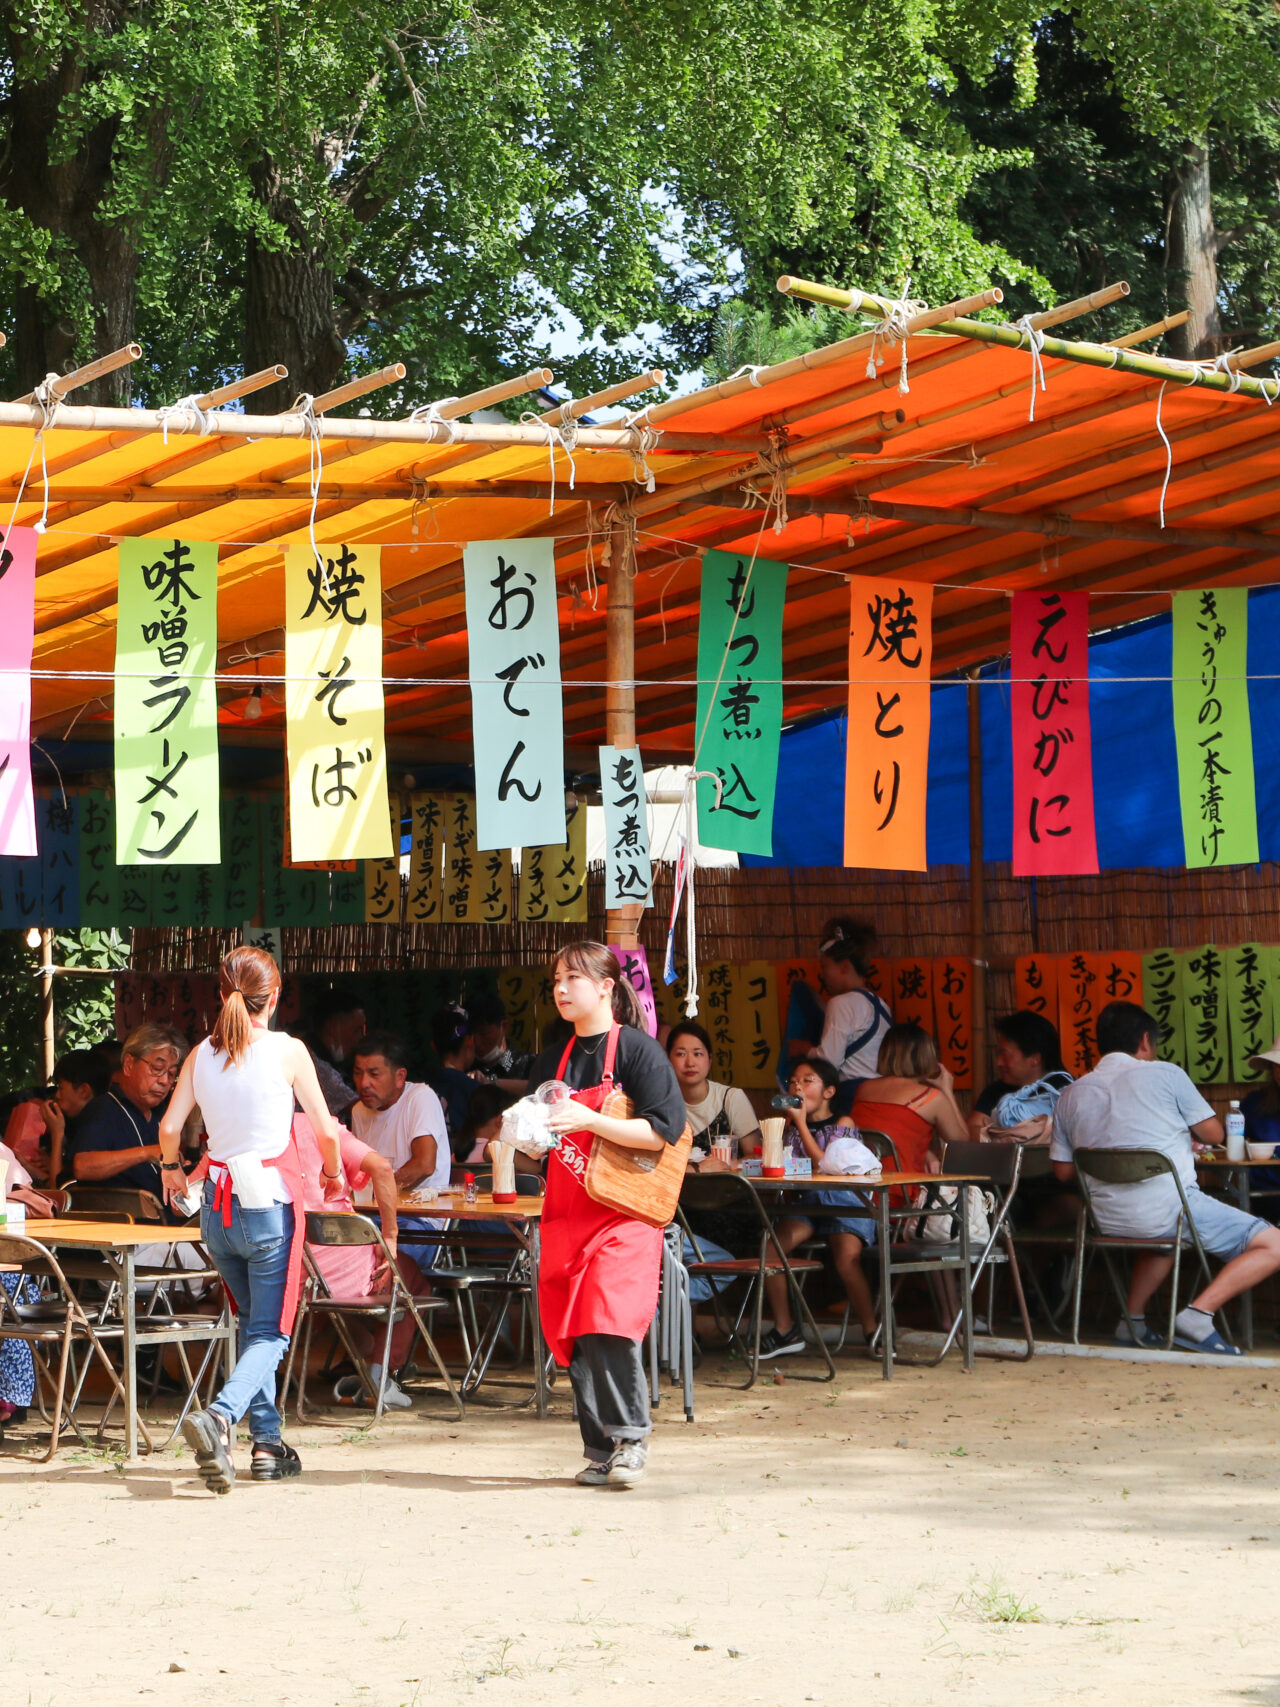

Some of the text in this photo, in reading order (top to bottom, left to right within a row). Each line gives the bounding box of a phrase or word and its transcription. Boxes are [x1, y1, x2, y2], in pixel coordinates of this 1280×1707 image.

[136, 538, 203, 859] 味噌ラーメン
[300, 544, 373, 807] 焼そば
[487, 555, 545, 802] おでん
[708, 560, 762, 820] もつ煮込
[862, 587, 923, 832] 焼とり
[1029, 593, 1074, 843] えびがに
[1196, 591, 1232, 865] きゅうりの一本漬け
[45, 799, 74, 914] 樽ハイ
[82, 803, 113, 906] おでん
[226, 796, 254, 911] えびがに
[411, 798, 441, 919] 味噌ラーメン
[449, 799, 474, 918] ネギ味噌
[481, 854, 507, 922] ラーメン
[526, 850, 548, 920] クラーメン
[612, 755, 648, 900] もつ煮込
[708, 963, 735, 1084] 焼酎の水割り
[748, 976, 770, 1069] コーラ
[942, 962, 969, 1076] おしんこ
[1025, 961, 1047, 1011] もつ
[1188, 949, 1223, 1082] 味噌ラーメン
